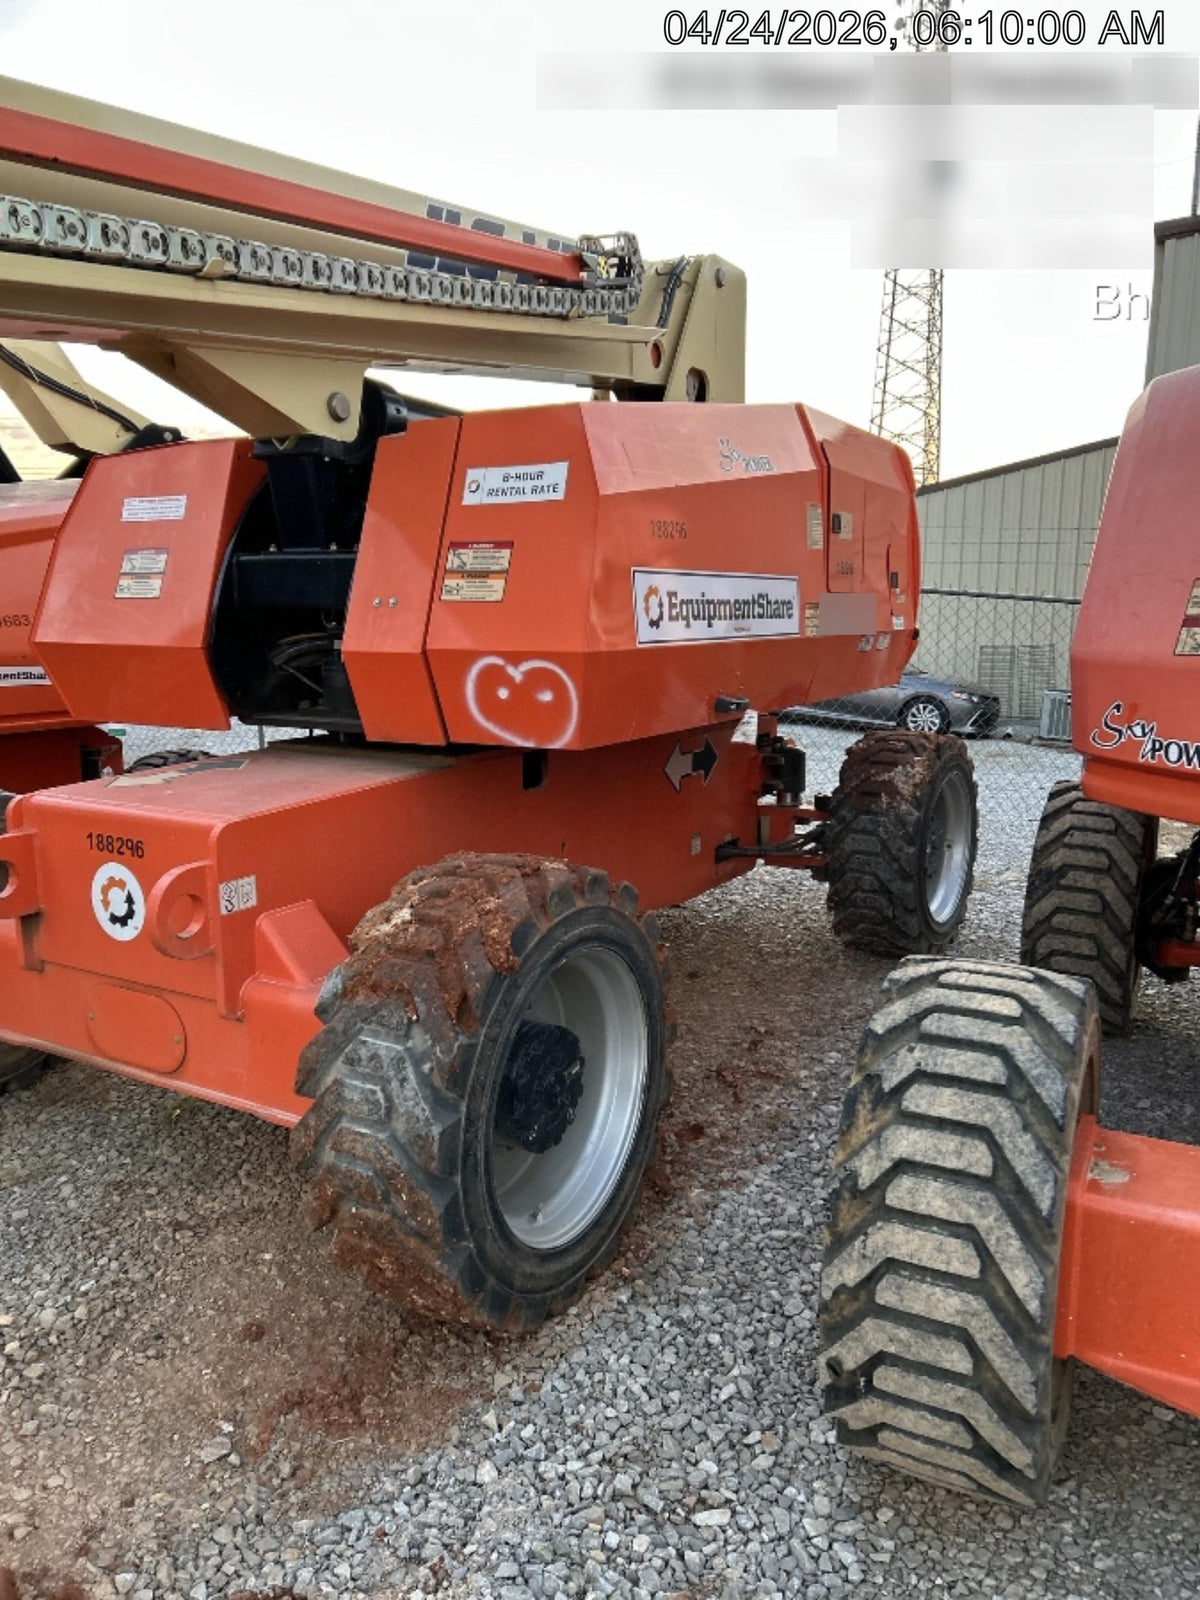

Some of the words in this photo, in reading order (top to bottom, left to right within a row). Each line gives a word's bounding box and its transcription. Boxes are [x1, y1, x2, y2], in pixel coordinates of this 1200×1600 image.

[486, 485, 527, 497] RENTAL
[531, 483, 559, 495] RATE
[666, 591, 797, 629] EquipmentShare
[0, 614, 31, 629] 683
[86, 831, 146, 860] 188296
